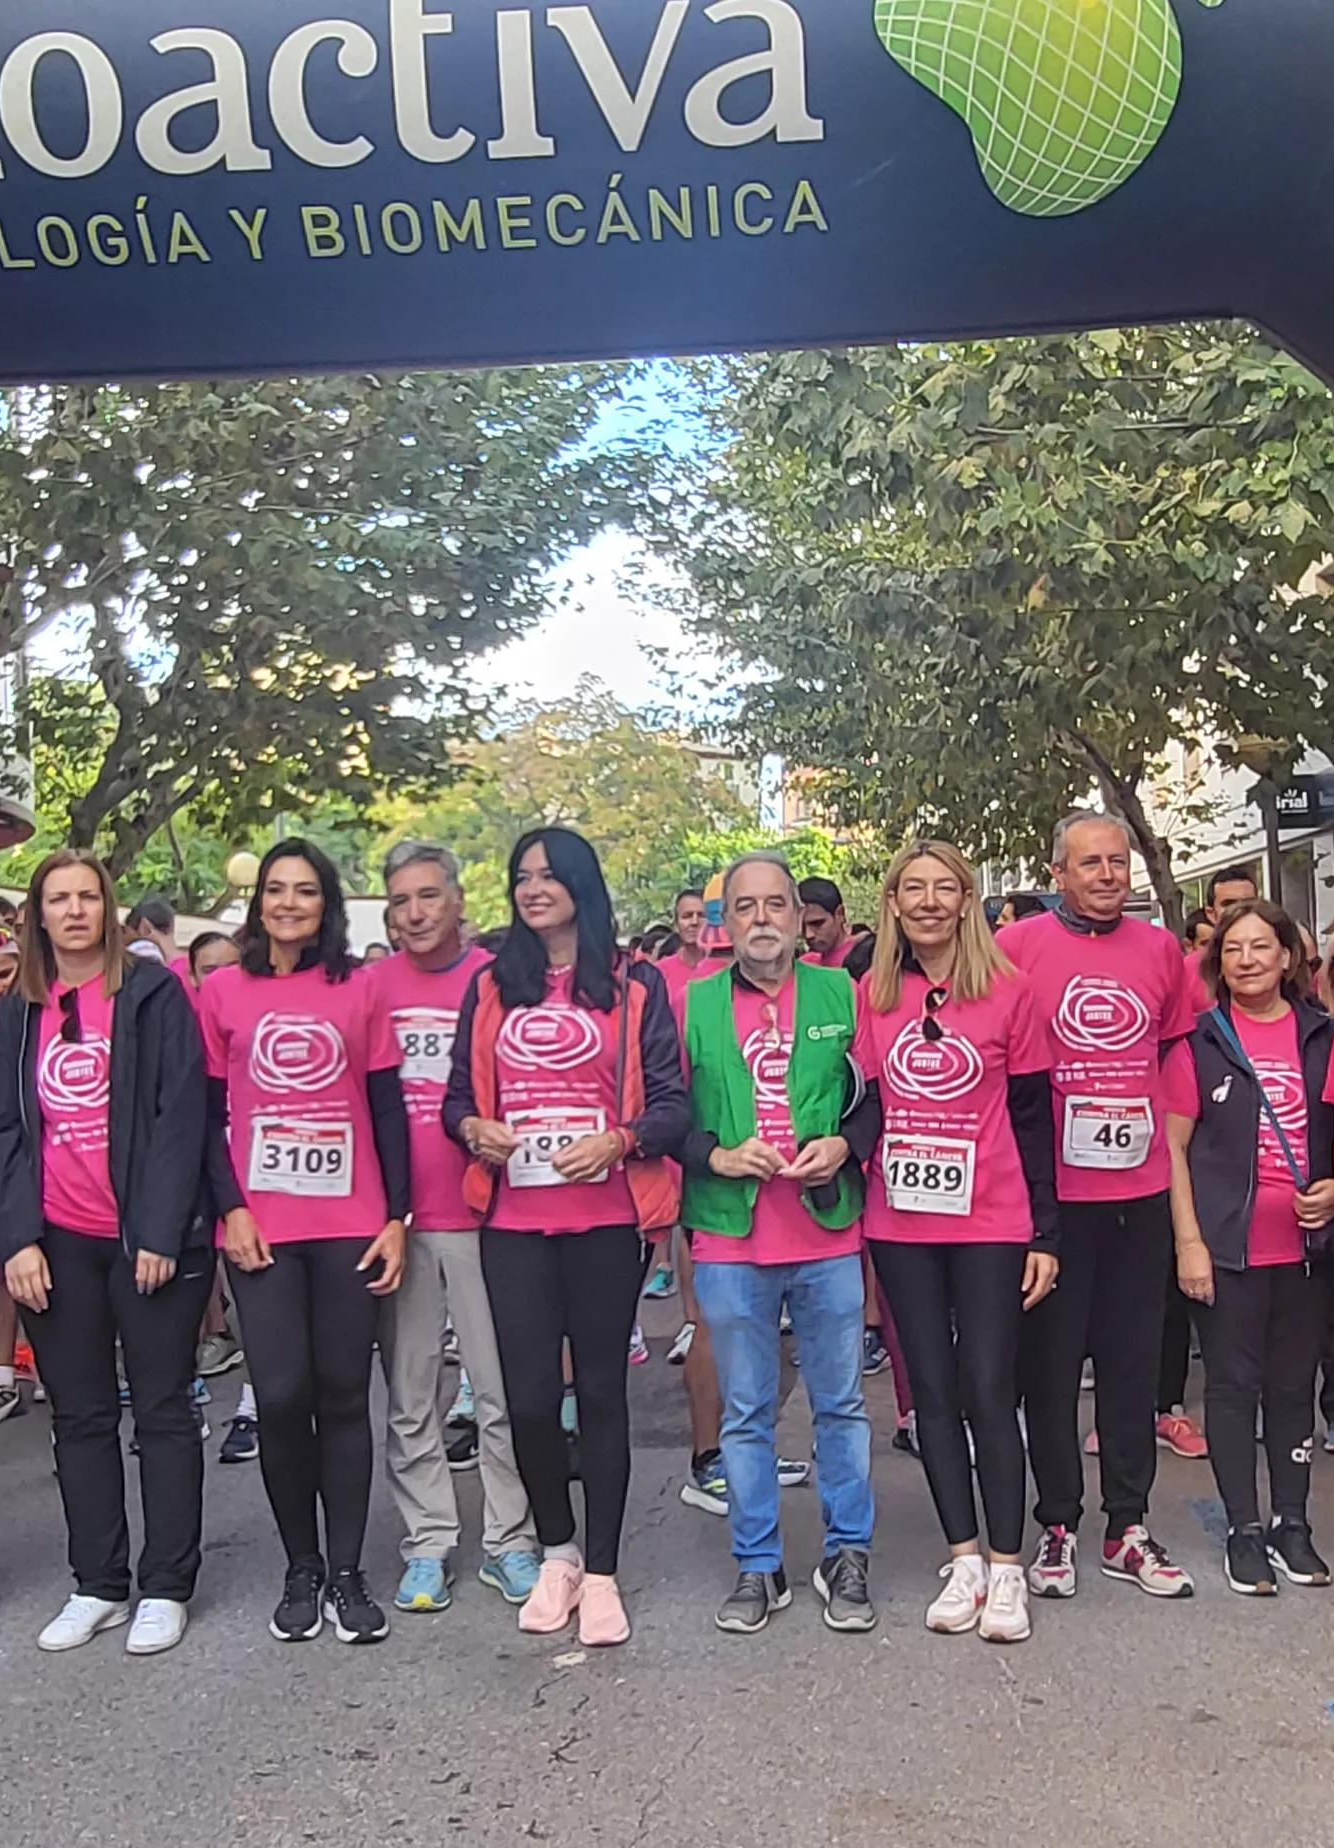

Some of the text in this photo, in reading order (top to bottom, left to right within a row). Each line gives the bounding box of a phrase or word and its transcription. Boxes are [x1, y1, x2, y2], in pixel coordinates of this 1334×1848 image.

[229, 207, 268, 261] Y
[304, 172, 831, 261] BIOMECÁNICA
[1093, 1122, 1133, 1149] 46
[262, 1144, 343, 1175] 3109
[888, 1159, 963, 1193] 1889
